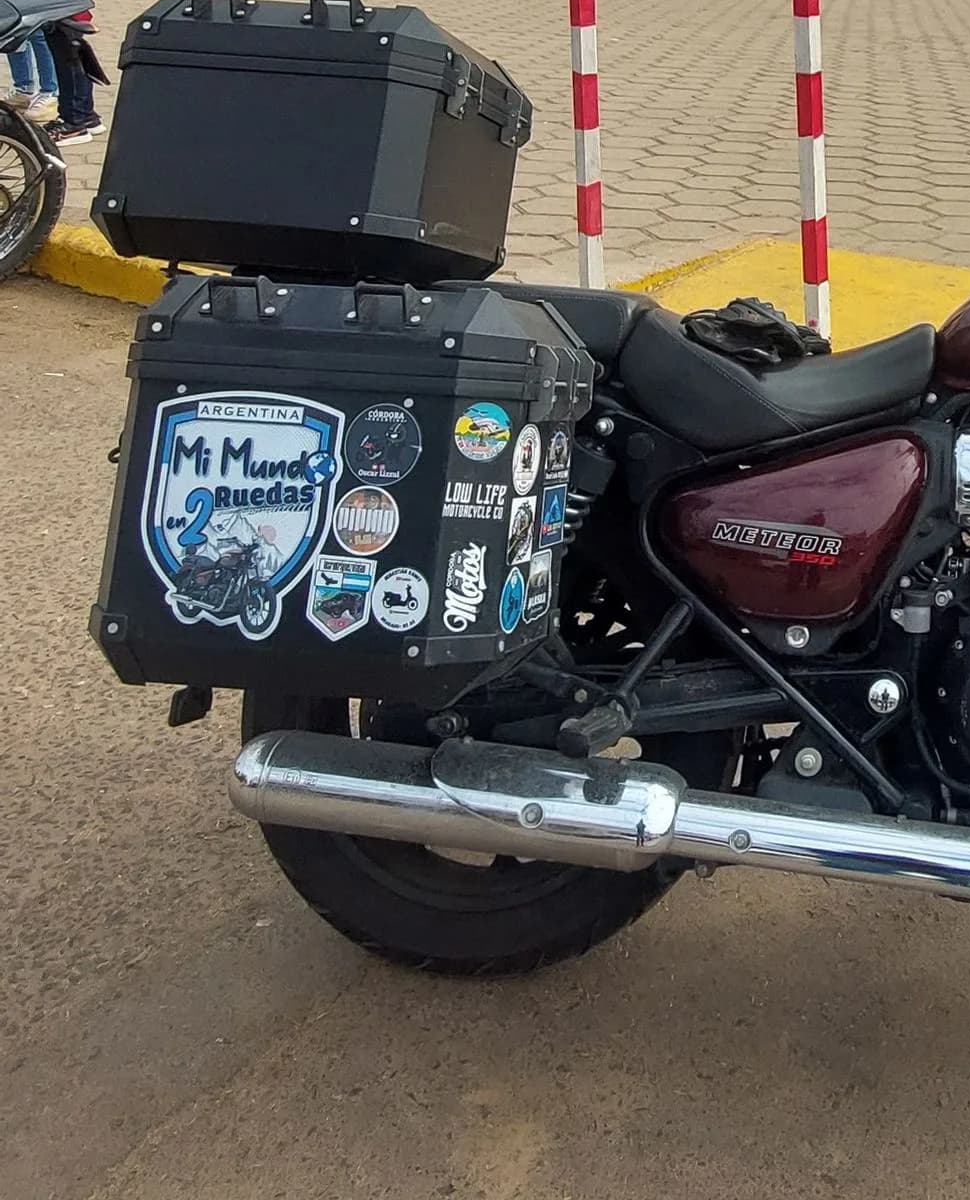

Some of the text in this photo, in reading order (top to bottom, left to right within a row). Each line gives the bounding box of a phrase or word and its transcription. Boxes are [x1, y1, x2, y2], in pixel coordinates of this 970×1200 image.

[200, 404, 300, 420] ARGENTINA
[173, 436, 210, 476] Mi
[445, 482, 507, 505] LOW LIFE
[166, 481, 315, 546] en 2 Ruedas
[493, 506, 504, 519] CO
[712, 522, 842, 555] METEOR
[790, 551, 837, 565] 350
[443, 542, 487, 632] Motos
